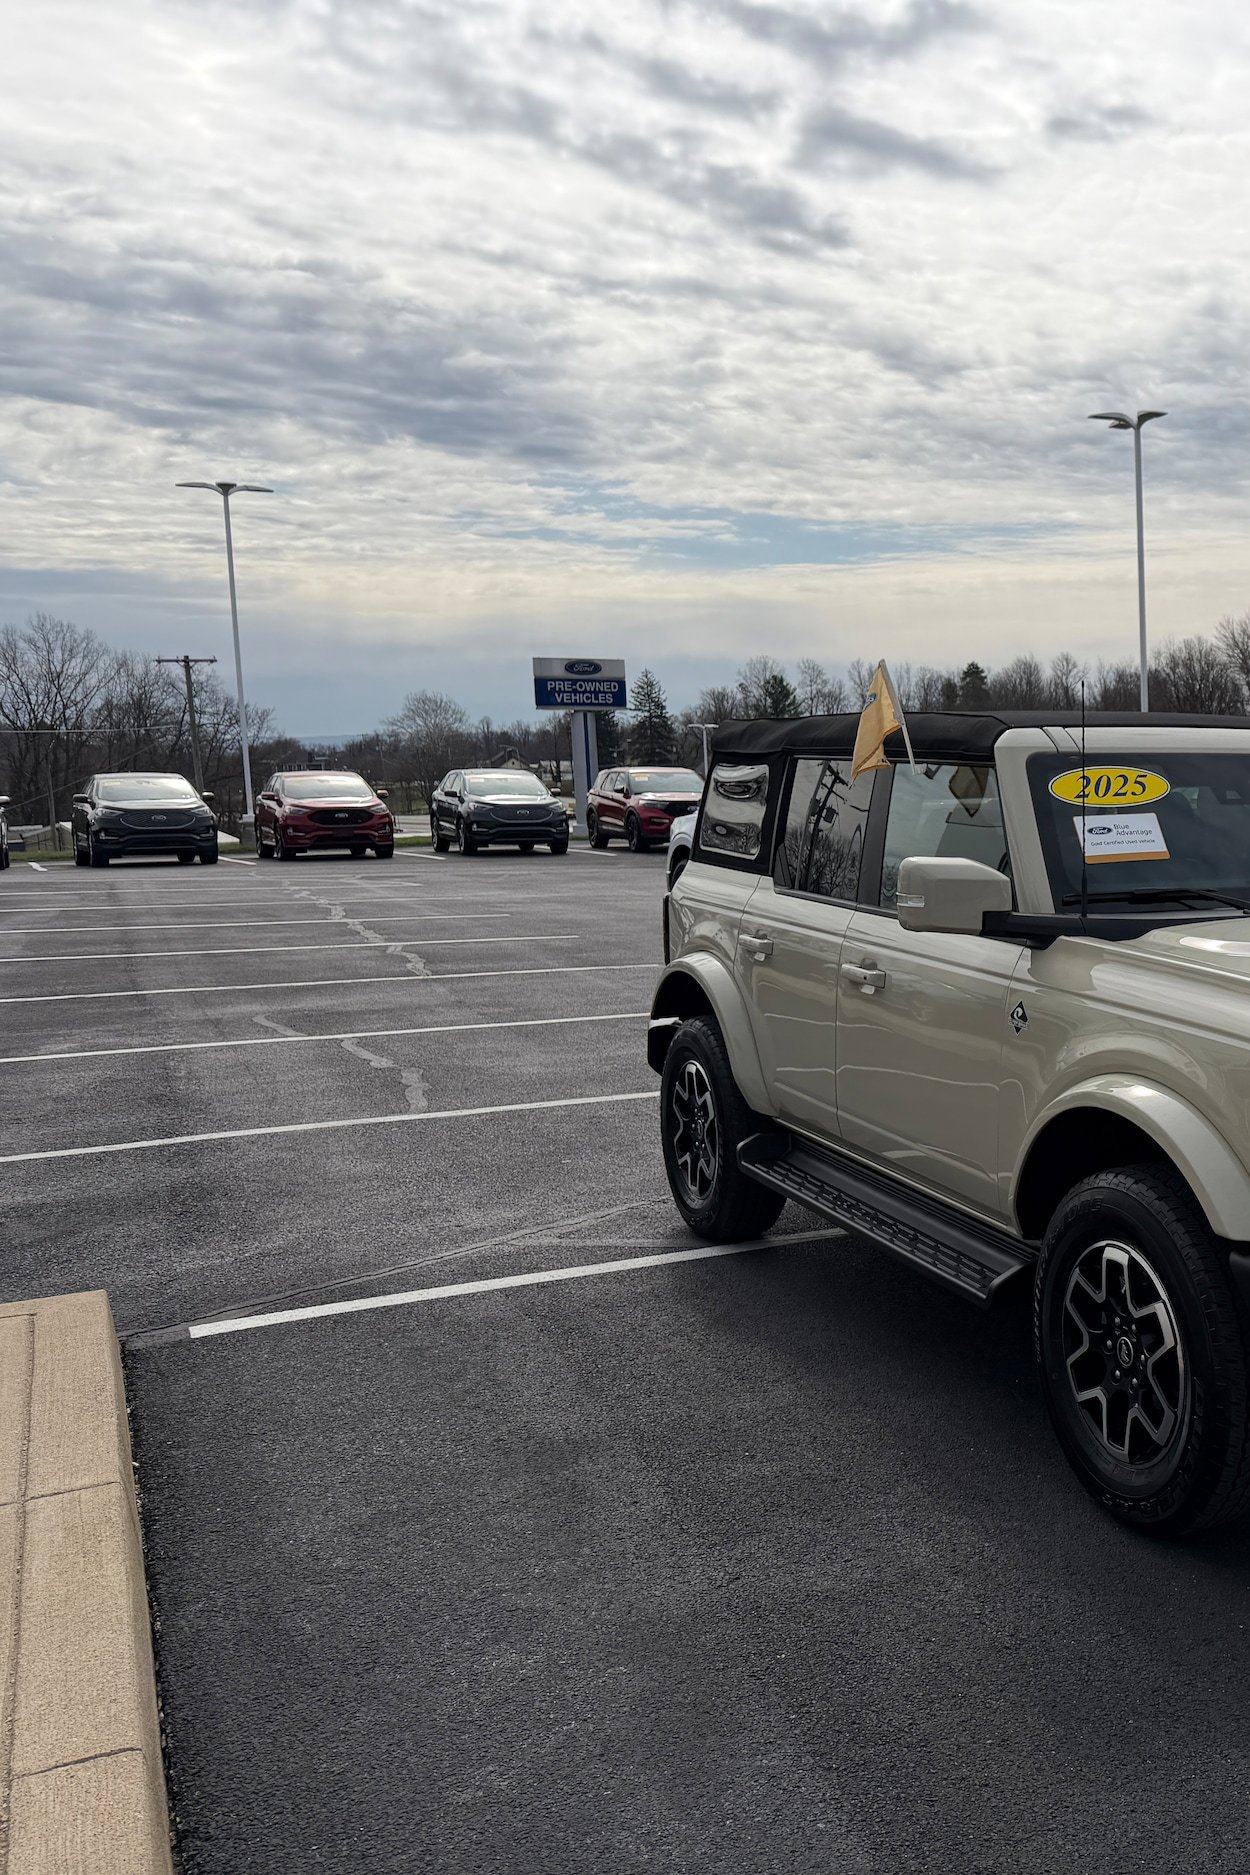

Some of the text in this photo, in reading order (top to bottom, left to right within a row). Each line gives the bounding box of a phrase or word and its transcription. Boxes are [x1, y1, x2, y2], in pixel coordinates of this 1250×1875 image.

[572, 663, 595, 673] Ford
[547, 681, 619, 692] PRE-OWNED
[554, 692, 614, 704] VEHICLES
[1074, 774, 1148, 799] 2025
[1091, 827, 1109, 835] Ford
[1116, 829, 1153, 837] Advantage
